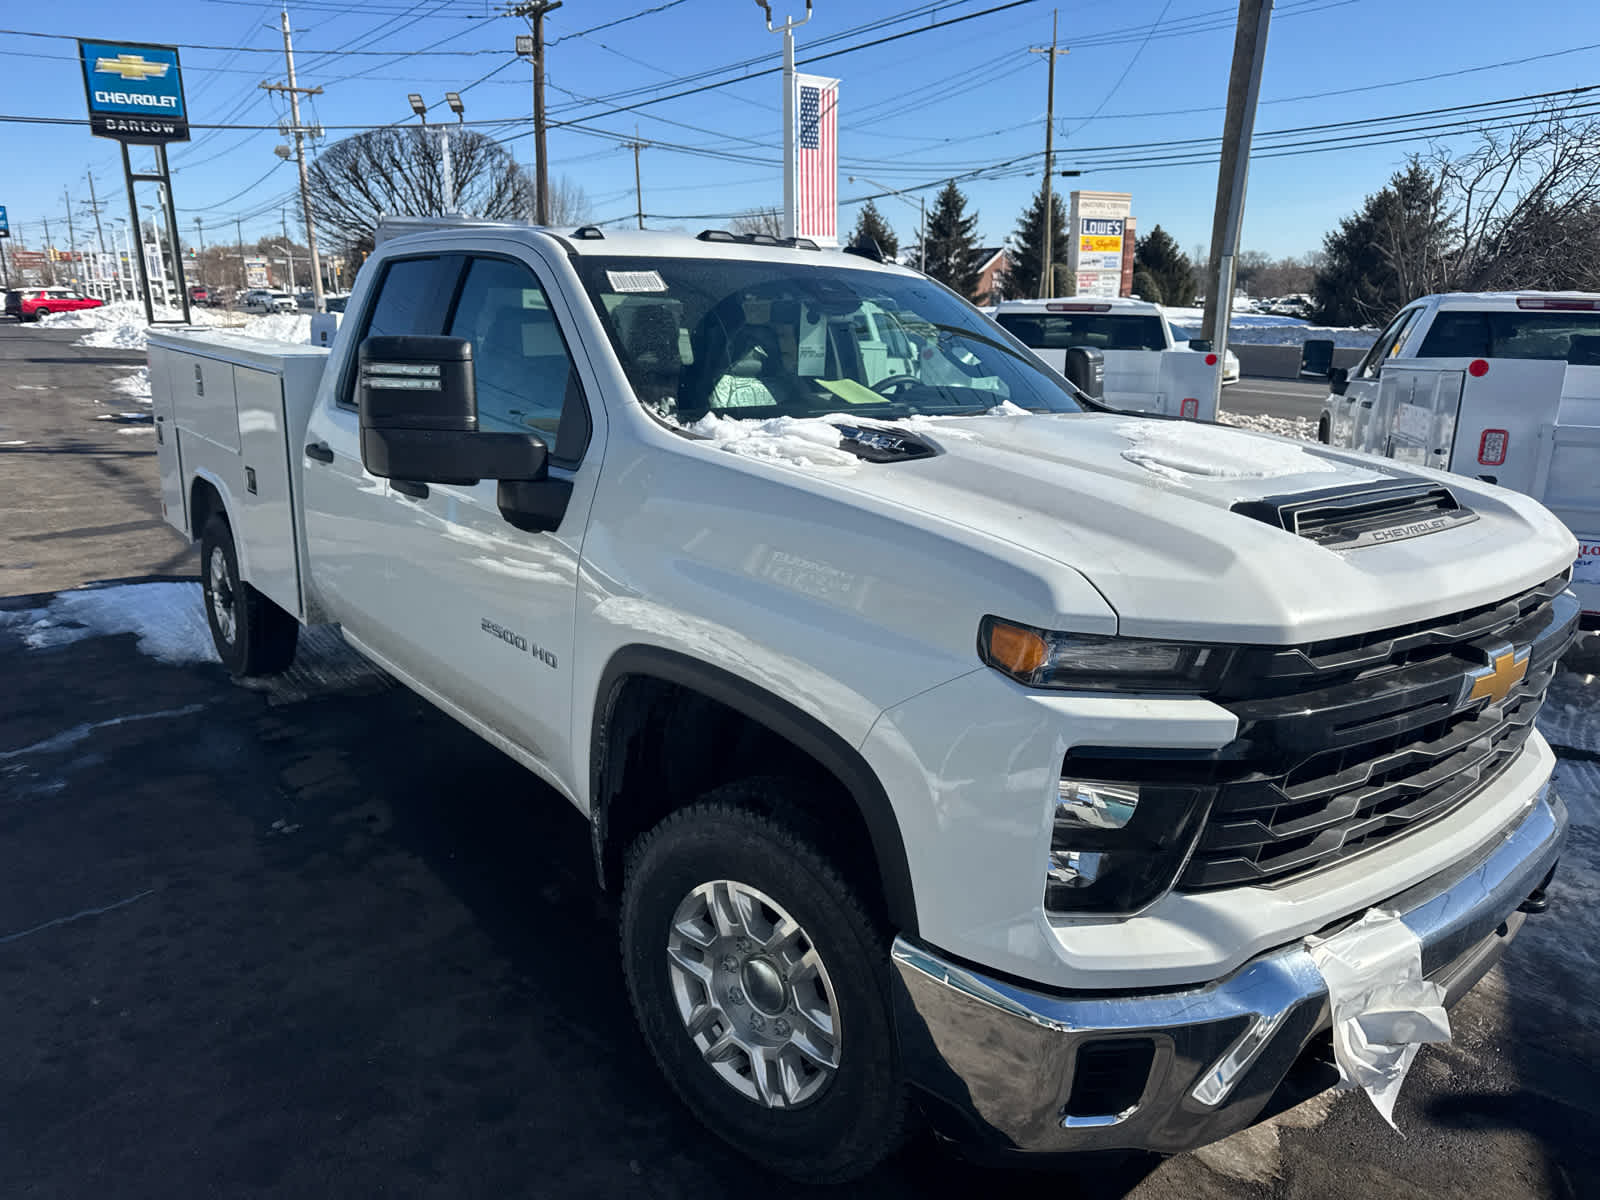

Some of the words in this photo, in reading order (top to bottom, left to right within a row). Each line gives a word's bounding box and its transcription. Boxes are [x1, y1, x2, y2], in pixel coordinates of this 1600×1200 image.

[95, 91, 177, 108] CHEVROLET
[106, 119, 175, 133] BARLOW
[1083, 219, 1121, 235] LOWE'S
[1372, 519, 1447, 541] CHEVROLET
[481, 617, 528, 652] 2500
[532, 643, 558, 669] HD
